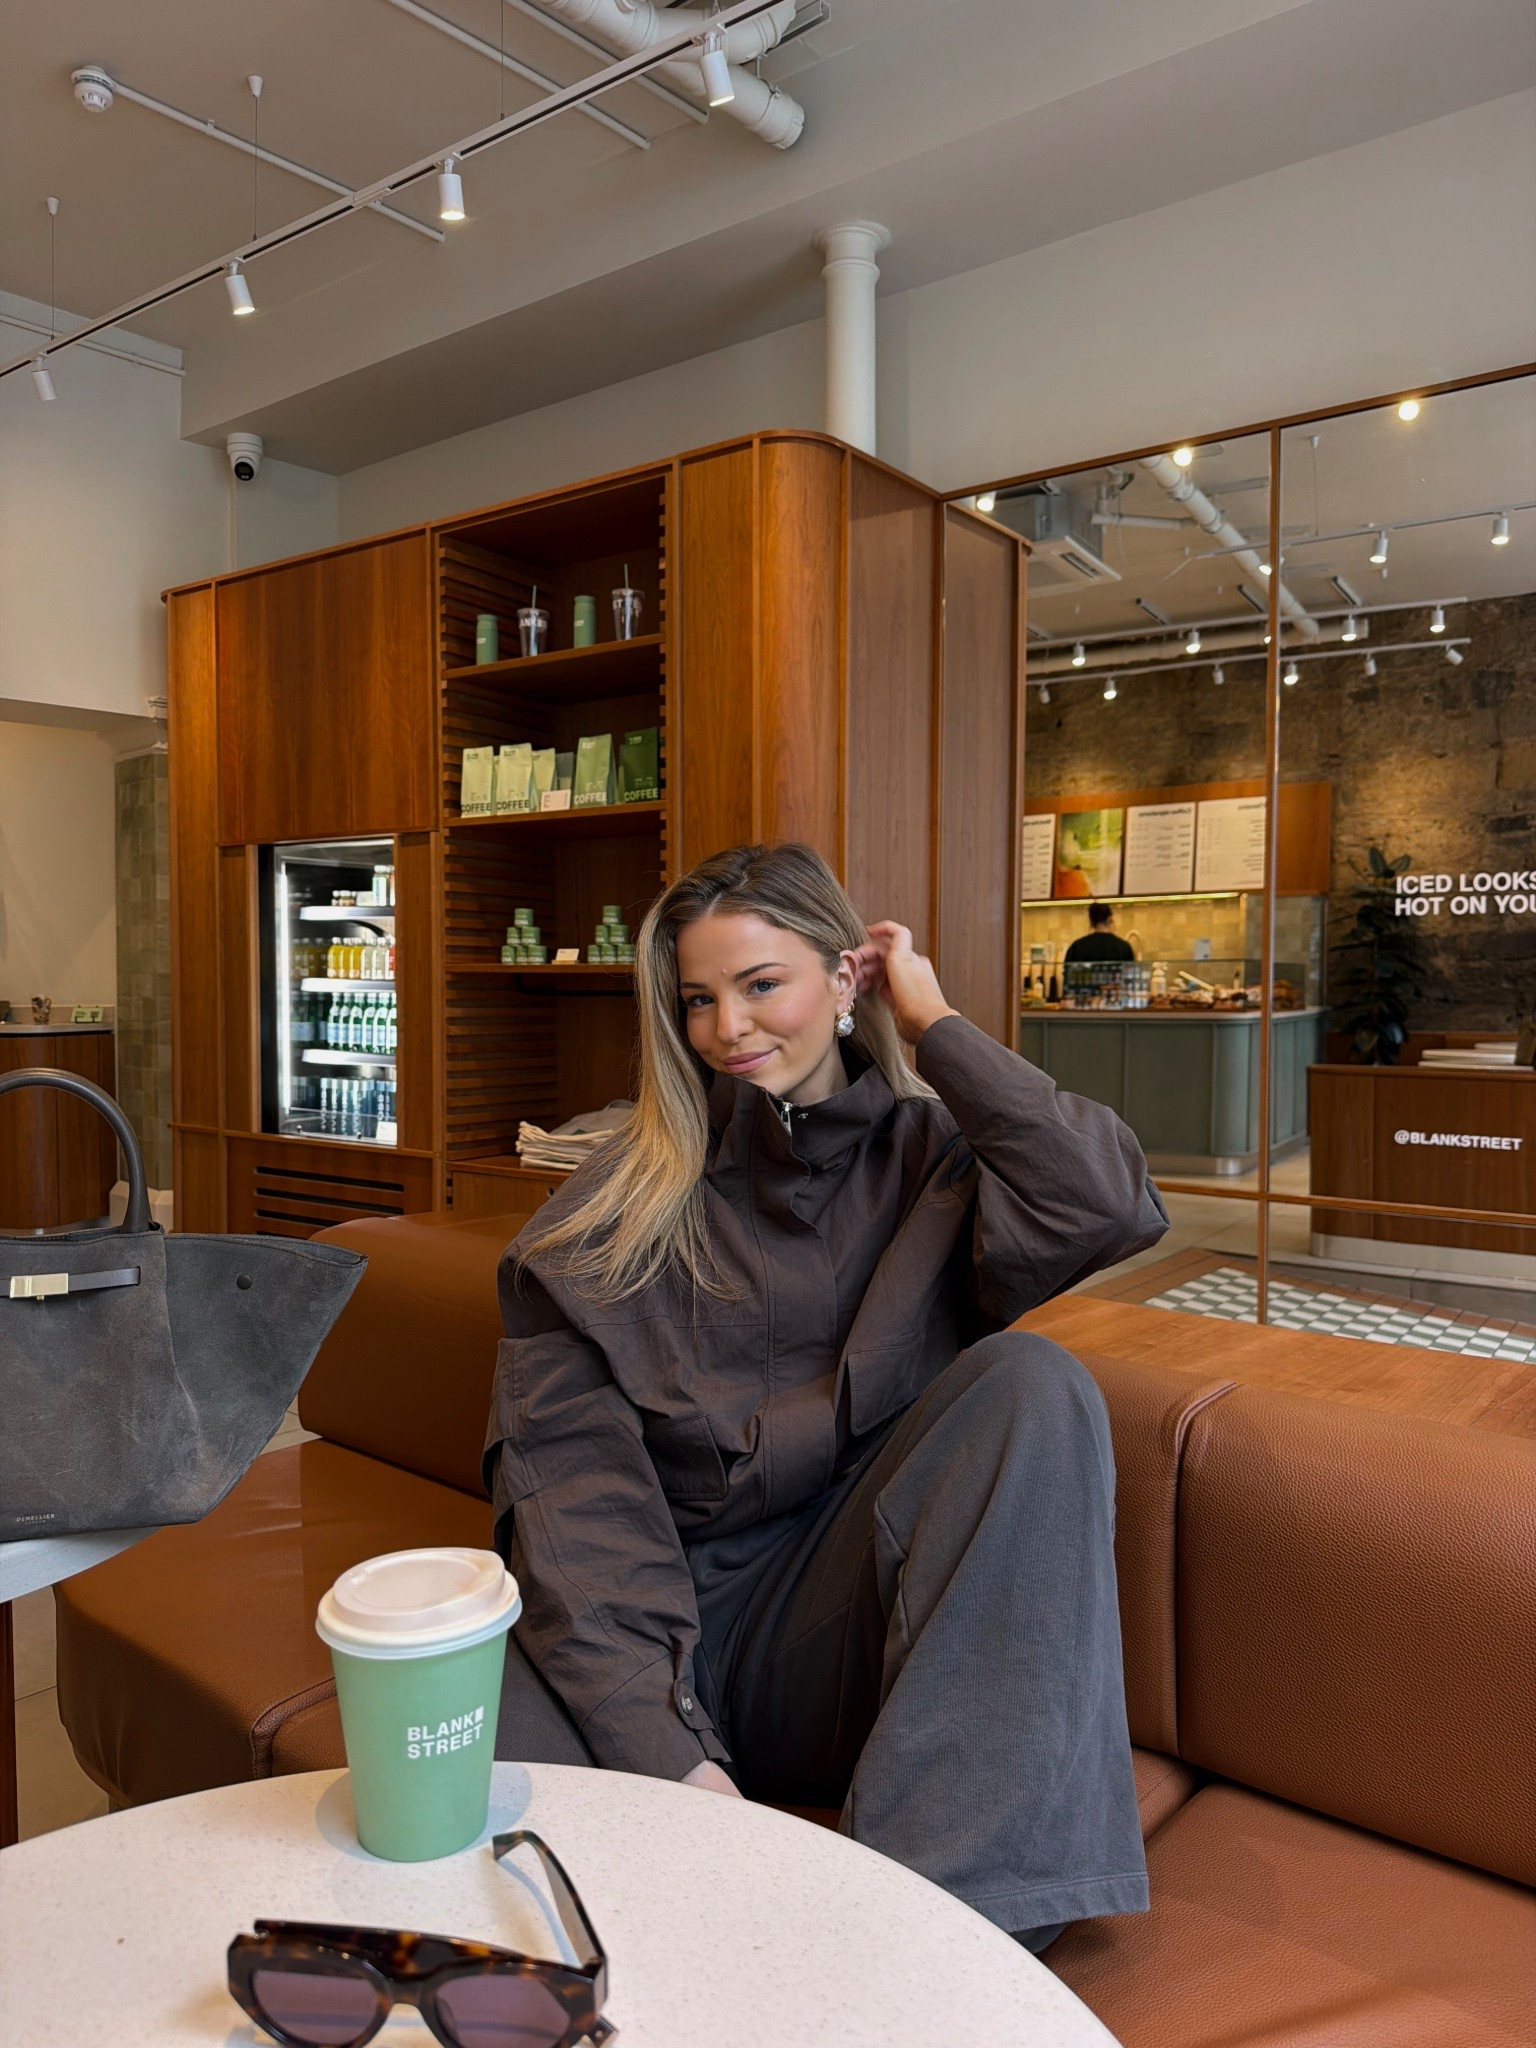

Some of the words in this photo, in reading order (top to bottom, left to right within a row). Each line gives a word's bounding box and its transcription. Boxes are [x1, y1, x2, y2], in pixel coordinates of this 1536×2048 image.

[496, 799, 530, 810] COFFEE
[574, 791, 607, 805] COFFEE
[624, 787, 659, 801] COFFEE
[461, 802, 493, 813] COFFEE
[1395, 874, 1453, 895] ICED
[1394, 897, 1445, 917] HOT
[1449, 895, 1487, 915] ON
[1394, 1129, 1523, 1151] @BLANKSTREET
[407, 1711, 474, 1742] BLANK
[407, 1722, 484, 1759] STREET
